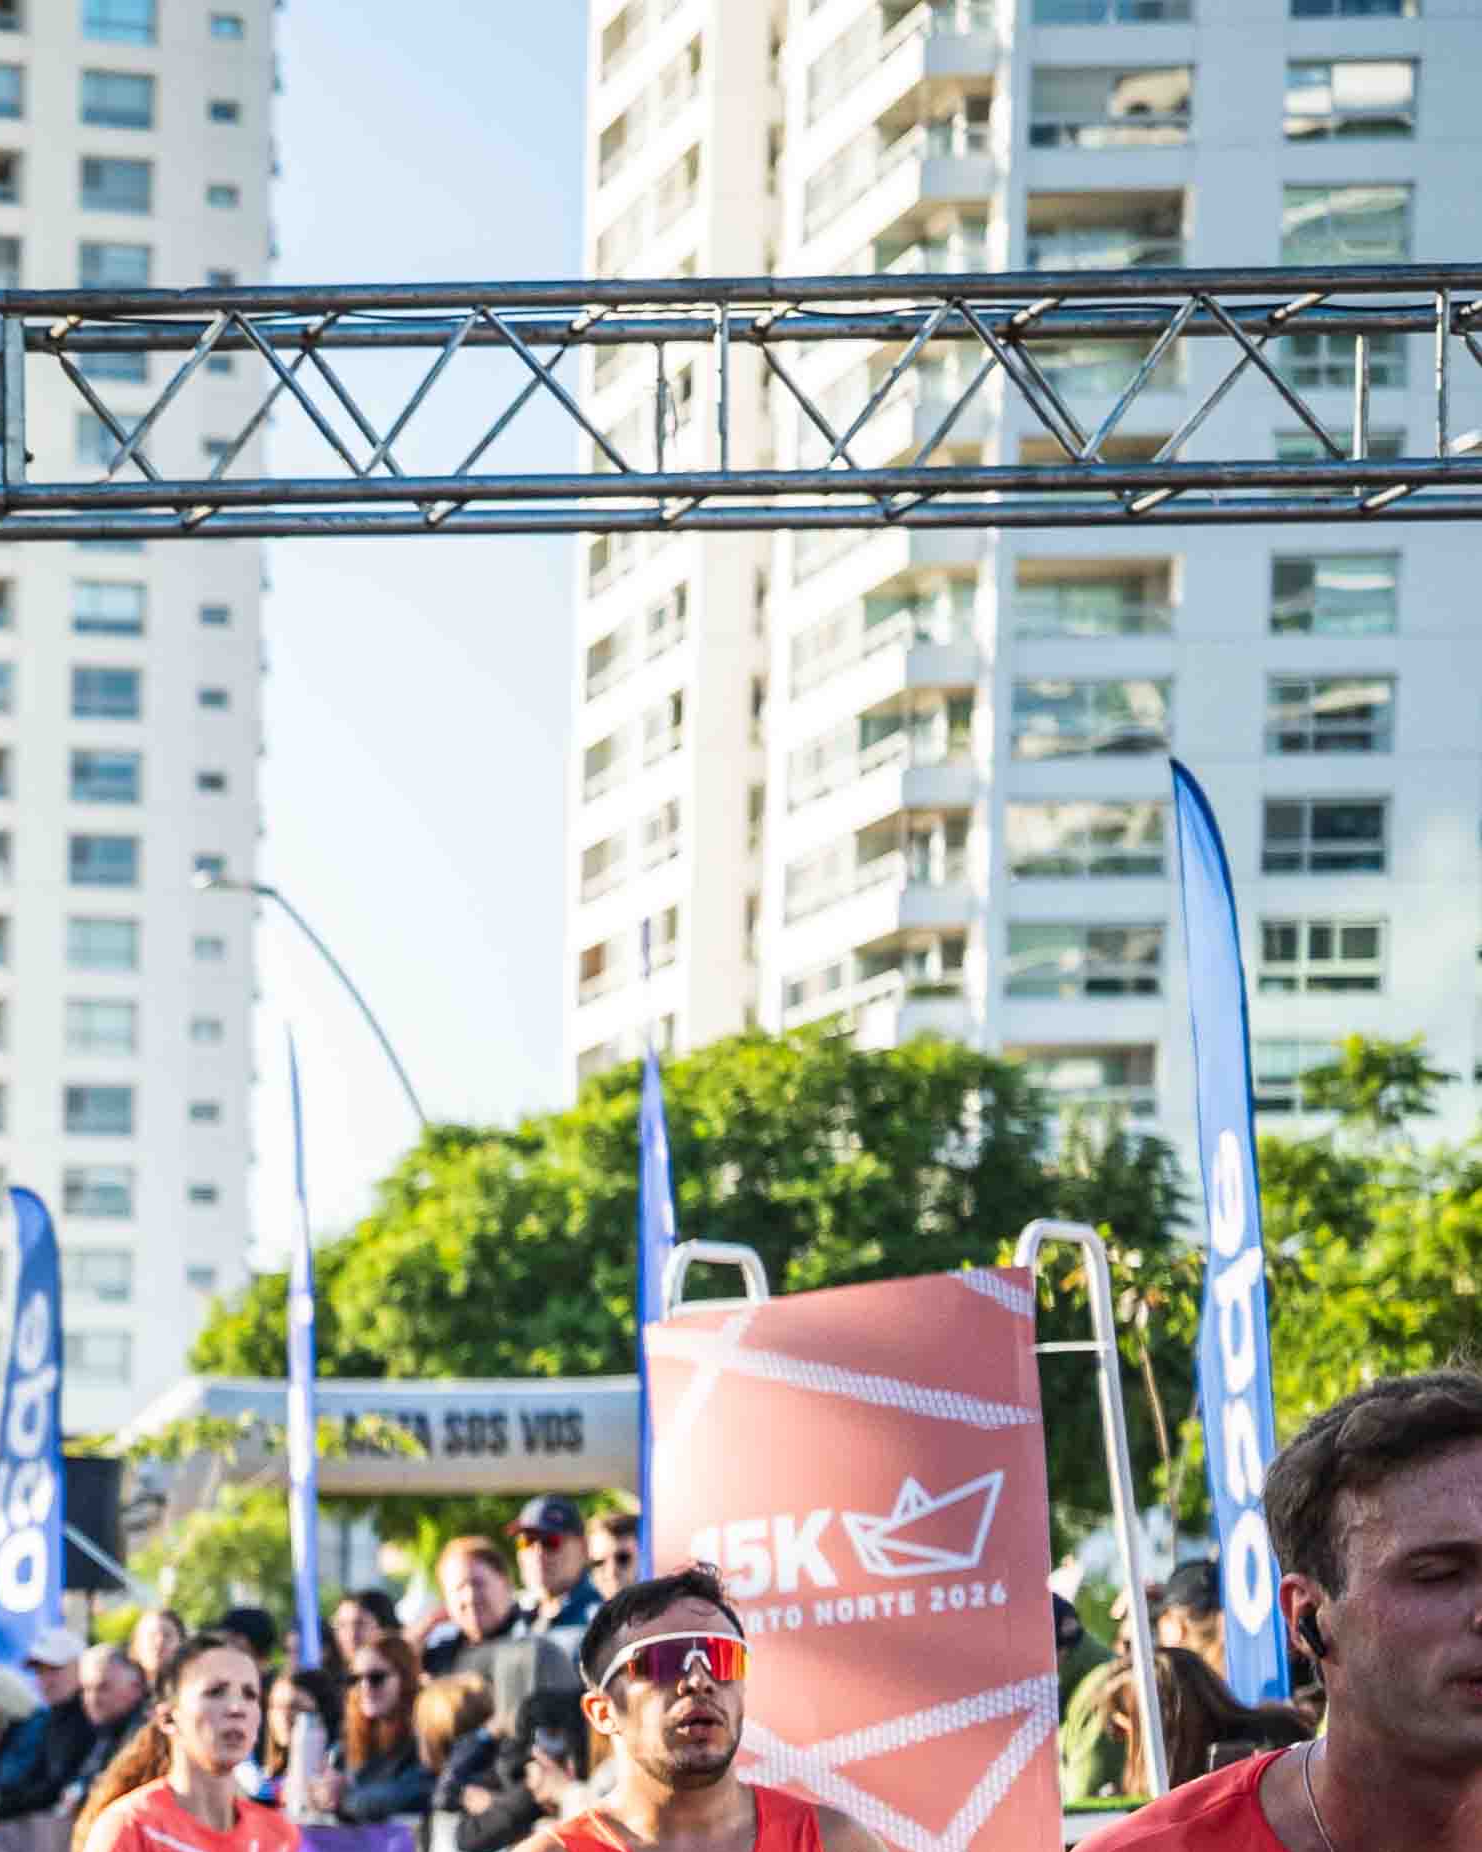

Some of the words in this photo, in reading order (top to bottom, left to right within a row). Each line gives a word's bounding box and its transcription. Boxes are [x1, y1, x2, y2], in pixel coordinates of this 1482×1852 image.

[739, 1604, 804, 1635] RTO
[814, 1589, 917, 1627] NORTE
[929, 1580, 1008, 1614] 2026
